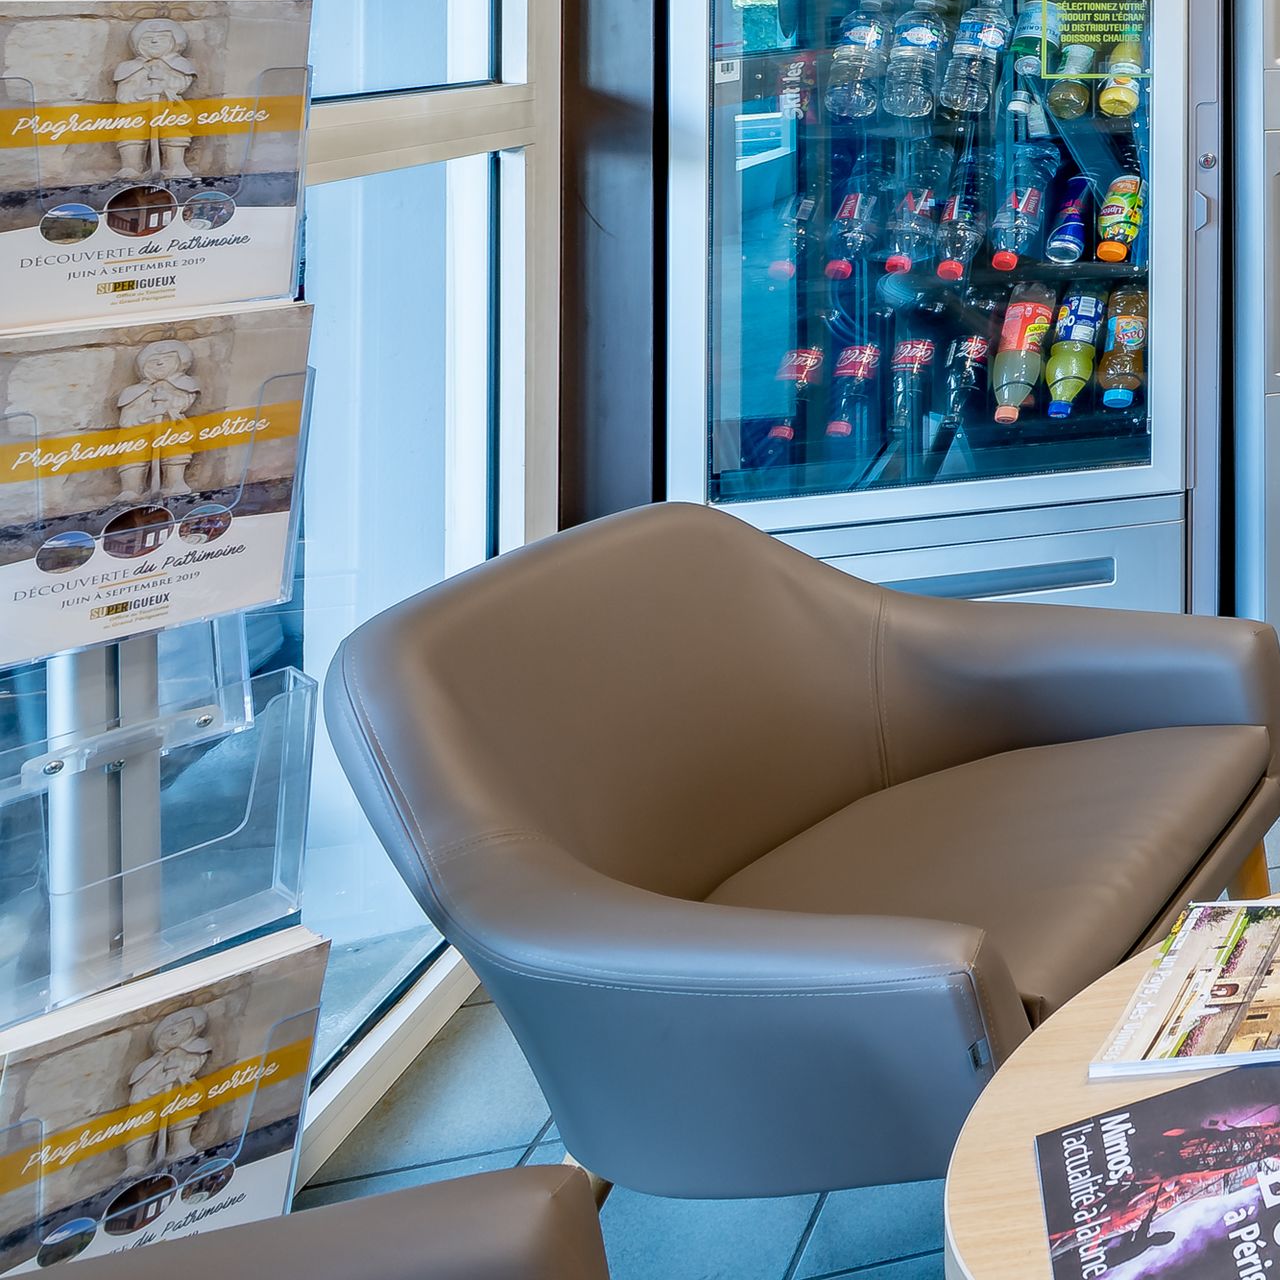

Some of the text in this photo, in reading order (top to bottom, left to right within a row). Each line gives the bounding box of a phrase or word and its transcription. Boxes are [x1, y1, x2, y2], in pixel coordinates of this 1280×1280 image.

[1056, 0, 1145, 12] SÉLECTIONNEZ VOTRE
[1056, 11, 1145, 22] PRODUIT SUR L'ÉCRAN
[1072, 23, 1128, 32] DISTRIBUTEUR
[1130, 23, 1143, 32] DE
[1060, 33, 1141, 44] BOISSONS CHAUDES
[12, 104, 270, 141] Programme des sorties
[21, 233, 251, 268] DÉCOUVERTE du Patrimoine
[97, 274, 176, 295] SUPERIGUEUX
[1117, 325, 1145, 342] Oasis
[1100, 1112, 1135, 1190] Mimos,
